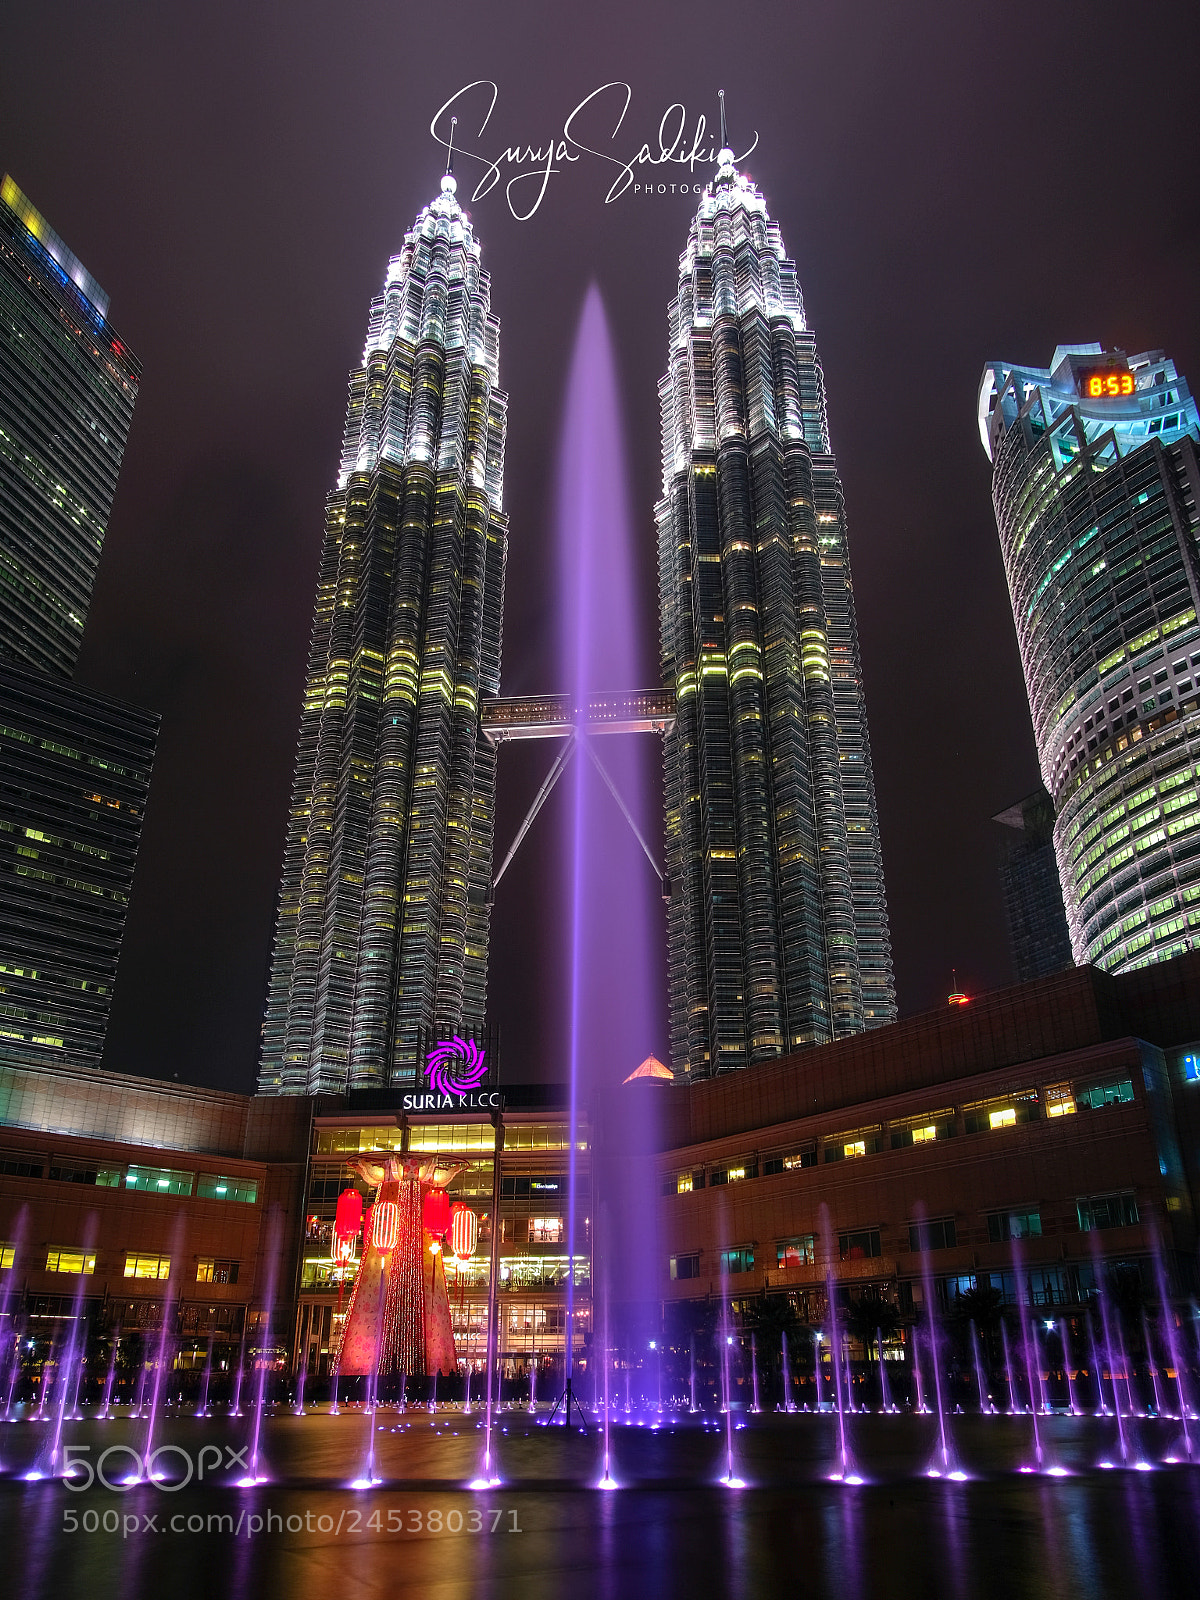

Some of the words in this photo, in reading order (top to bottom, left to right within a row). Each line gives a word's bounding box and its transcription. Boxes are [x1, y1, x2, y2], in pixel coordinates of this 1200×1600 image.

[1090, 375, 1133, 396] 8:53
[403, 1094, 454, 1110] SURIA
[459, 1092, 500, 1108] KLCC
